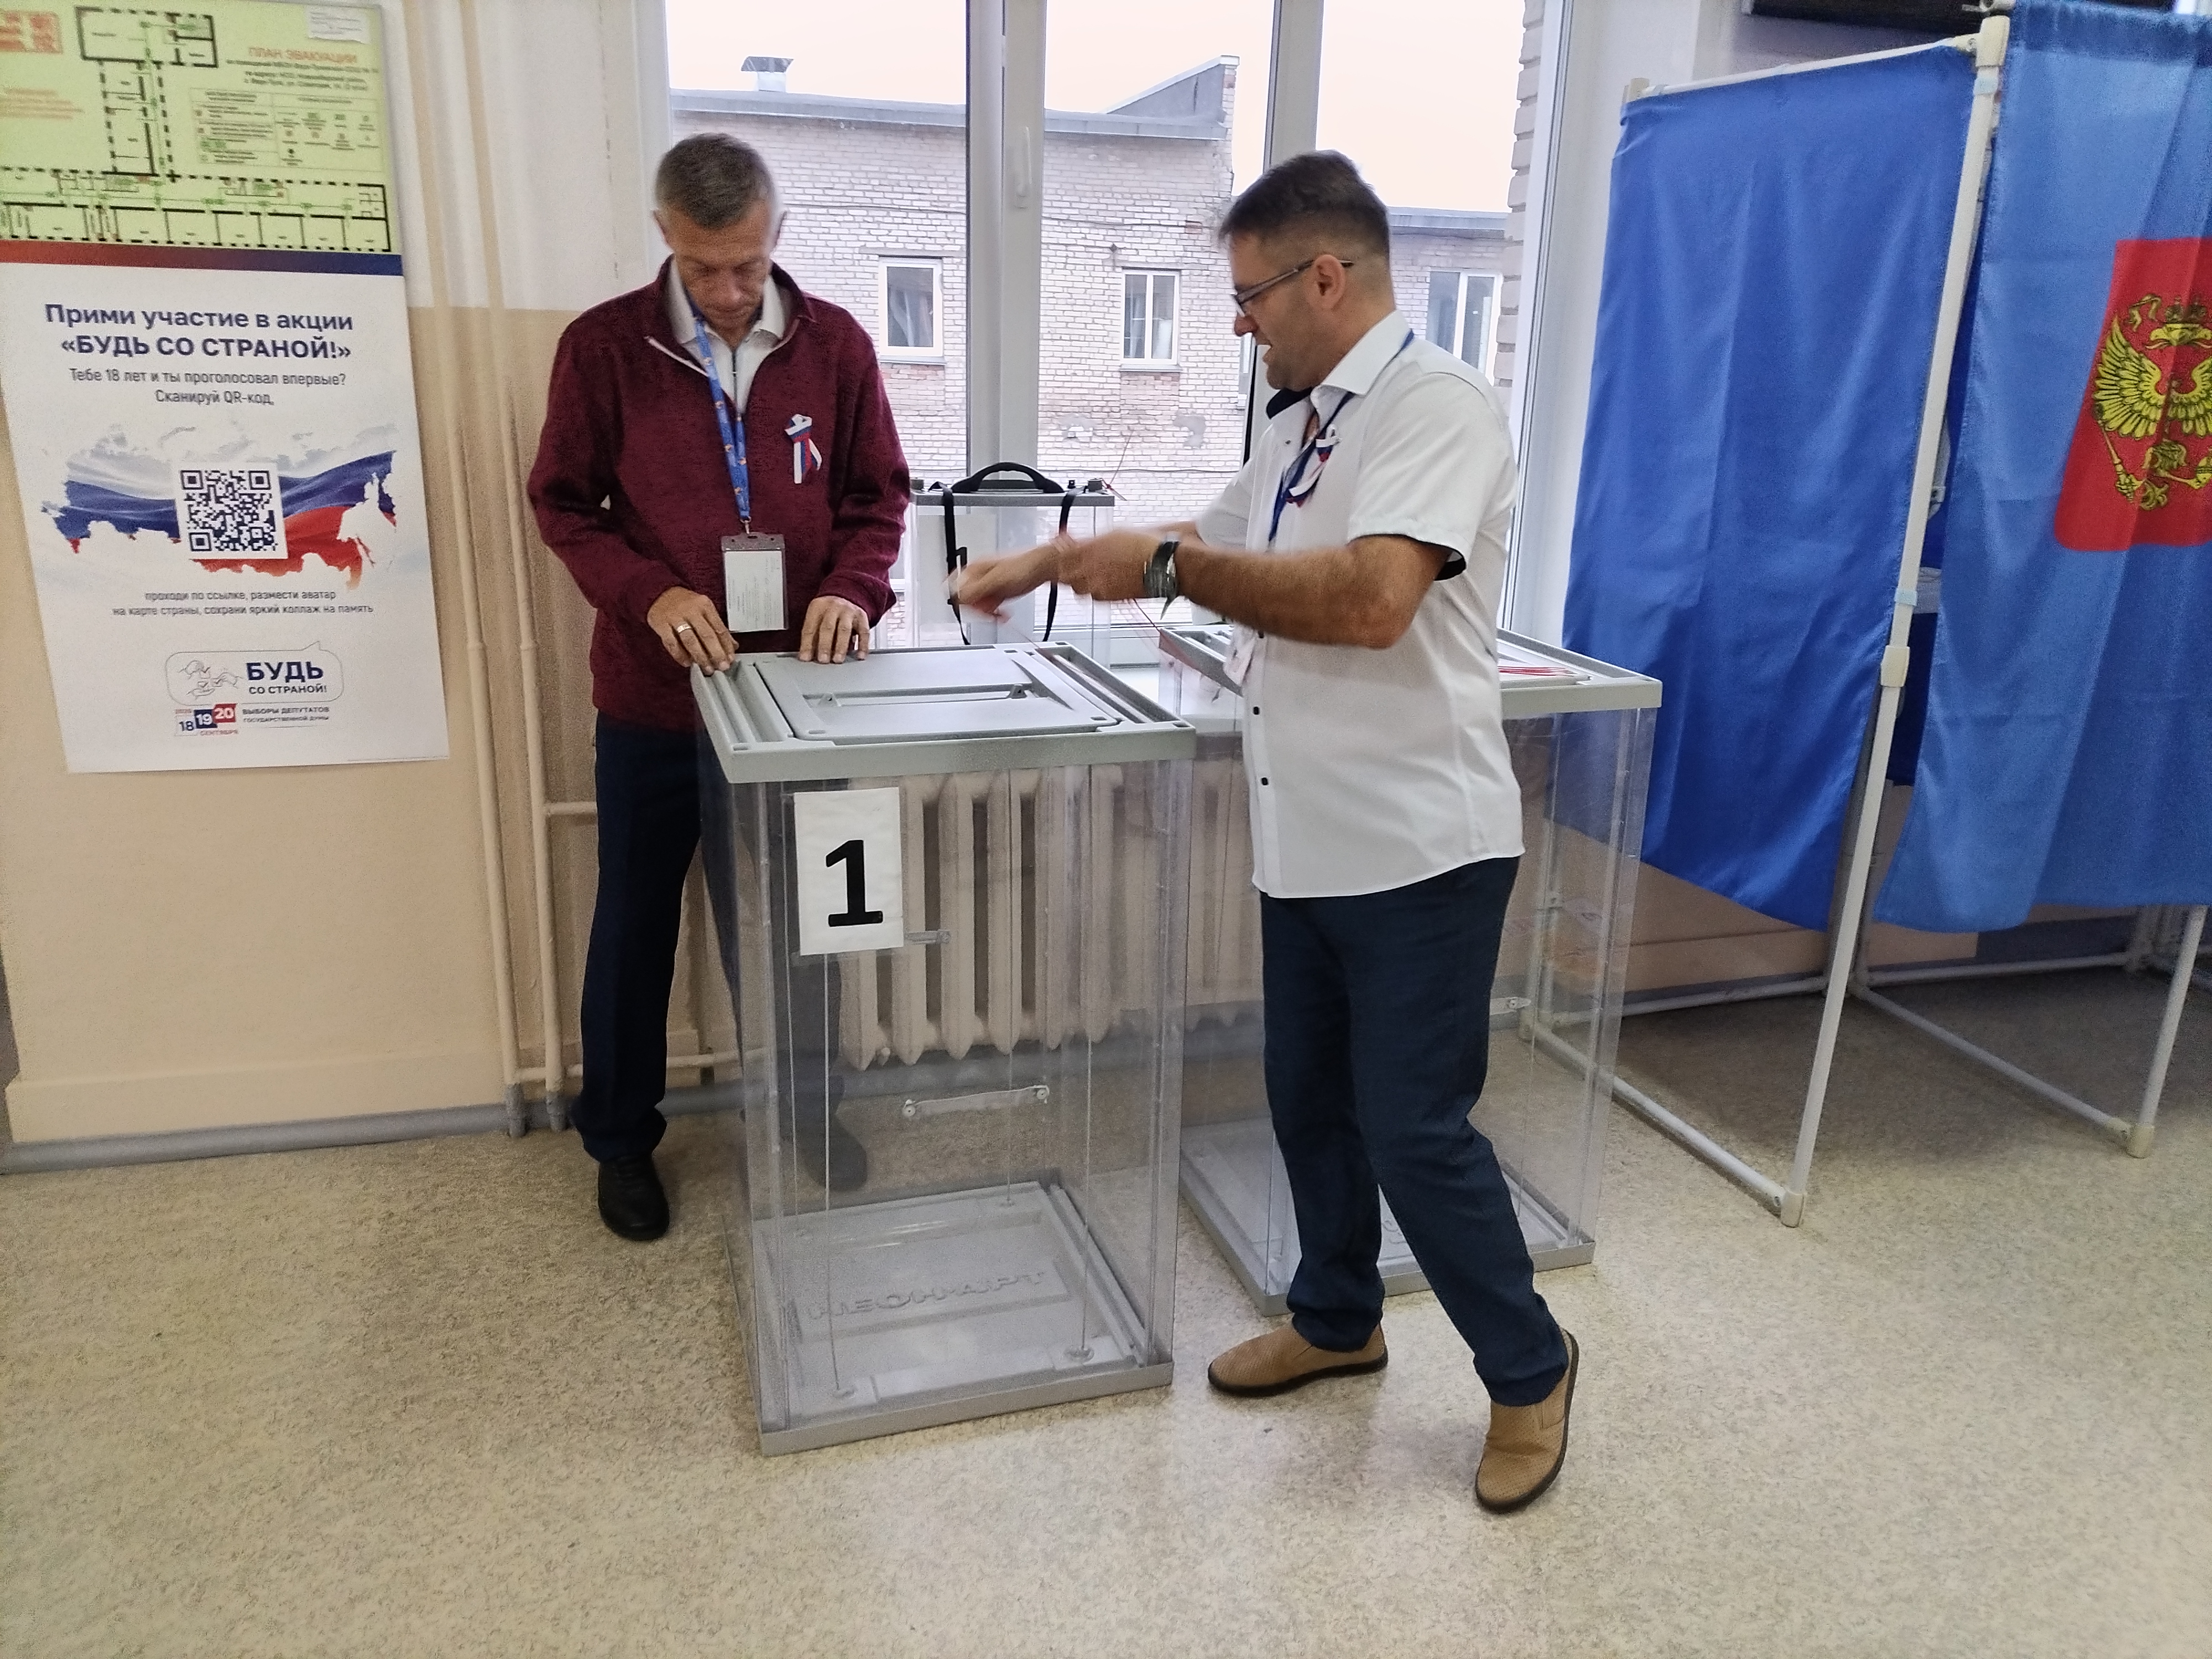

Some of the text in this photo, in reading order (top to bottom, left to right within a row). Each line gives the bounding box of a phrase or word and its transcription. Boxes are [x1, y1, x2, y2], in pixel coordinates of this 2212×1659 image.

[45, 304, 353, 332] Прими участие в акции
[61, 335, 352, 359] «БУДЬ СО СТРАНОЙ!»
[69, 368, 346, 388] Тебе 18 лет и ты проголосовал впервые?
[155, 389, 220, 406] Сканируй
[145, 592, 189, 602] проходи
[251, 592, 299, 601] размести
[301, 591, 337, 601] аватар
[160, 608, 201, 616] страны,
[204, 607, 247, 615] сохрани
[249, 604, 281, 615] яркий
[282, 606, 320, 614] коллаж
[246, 661, 324, 683] БУДЬ
[249, 684, 327, 695] СО СТРАНОЙ!
[179, 708, 234, 731] 18 19 20
[826, 839, 883, 927] 1
